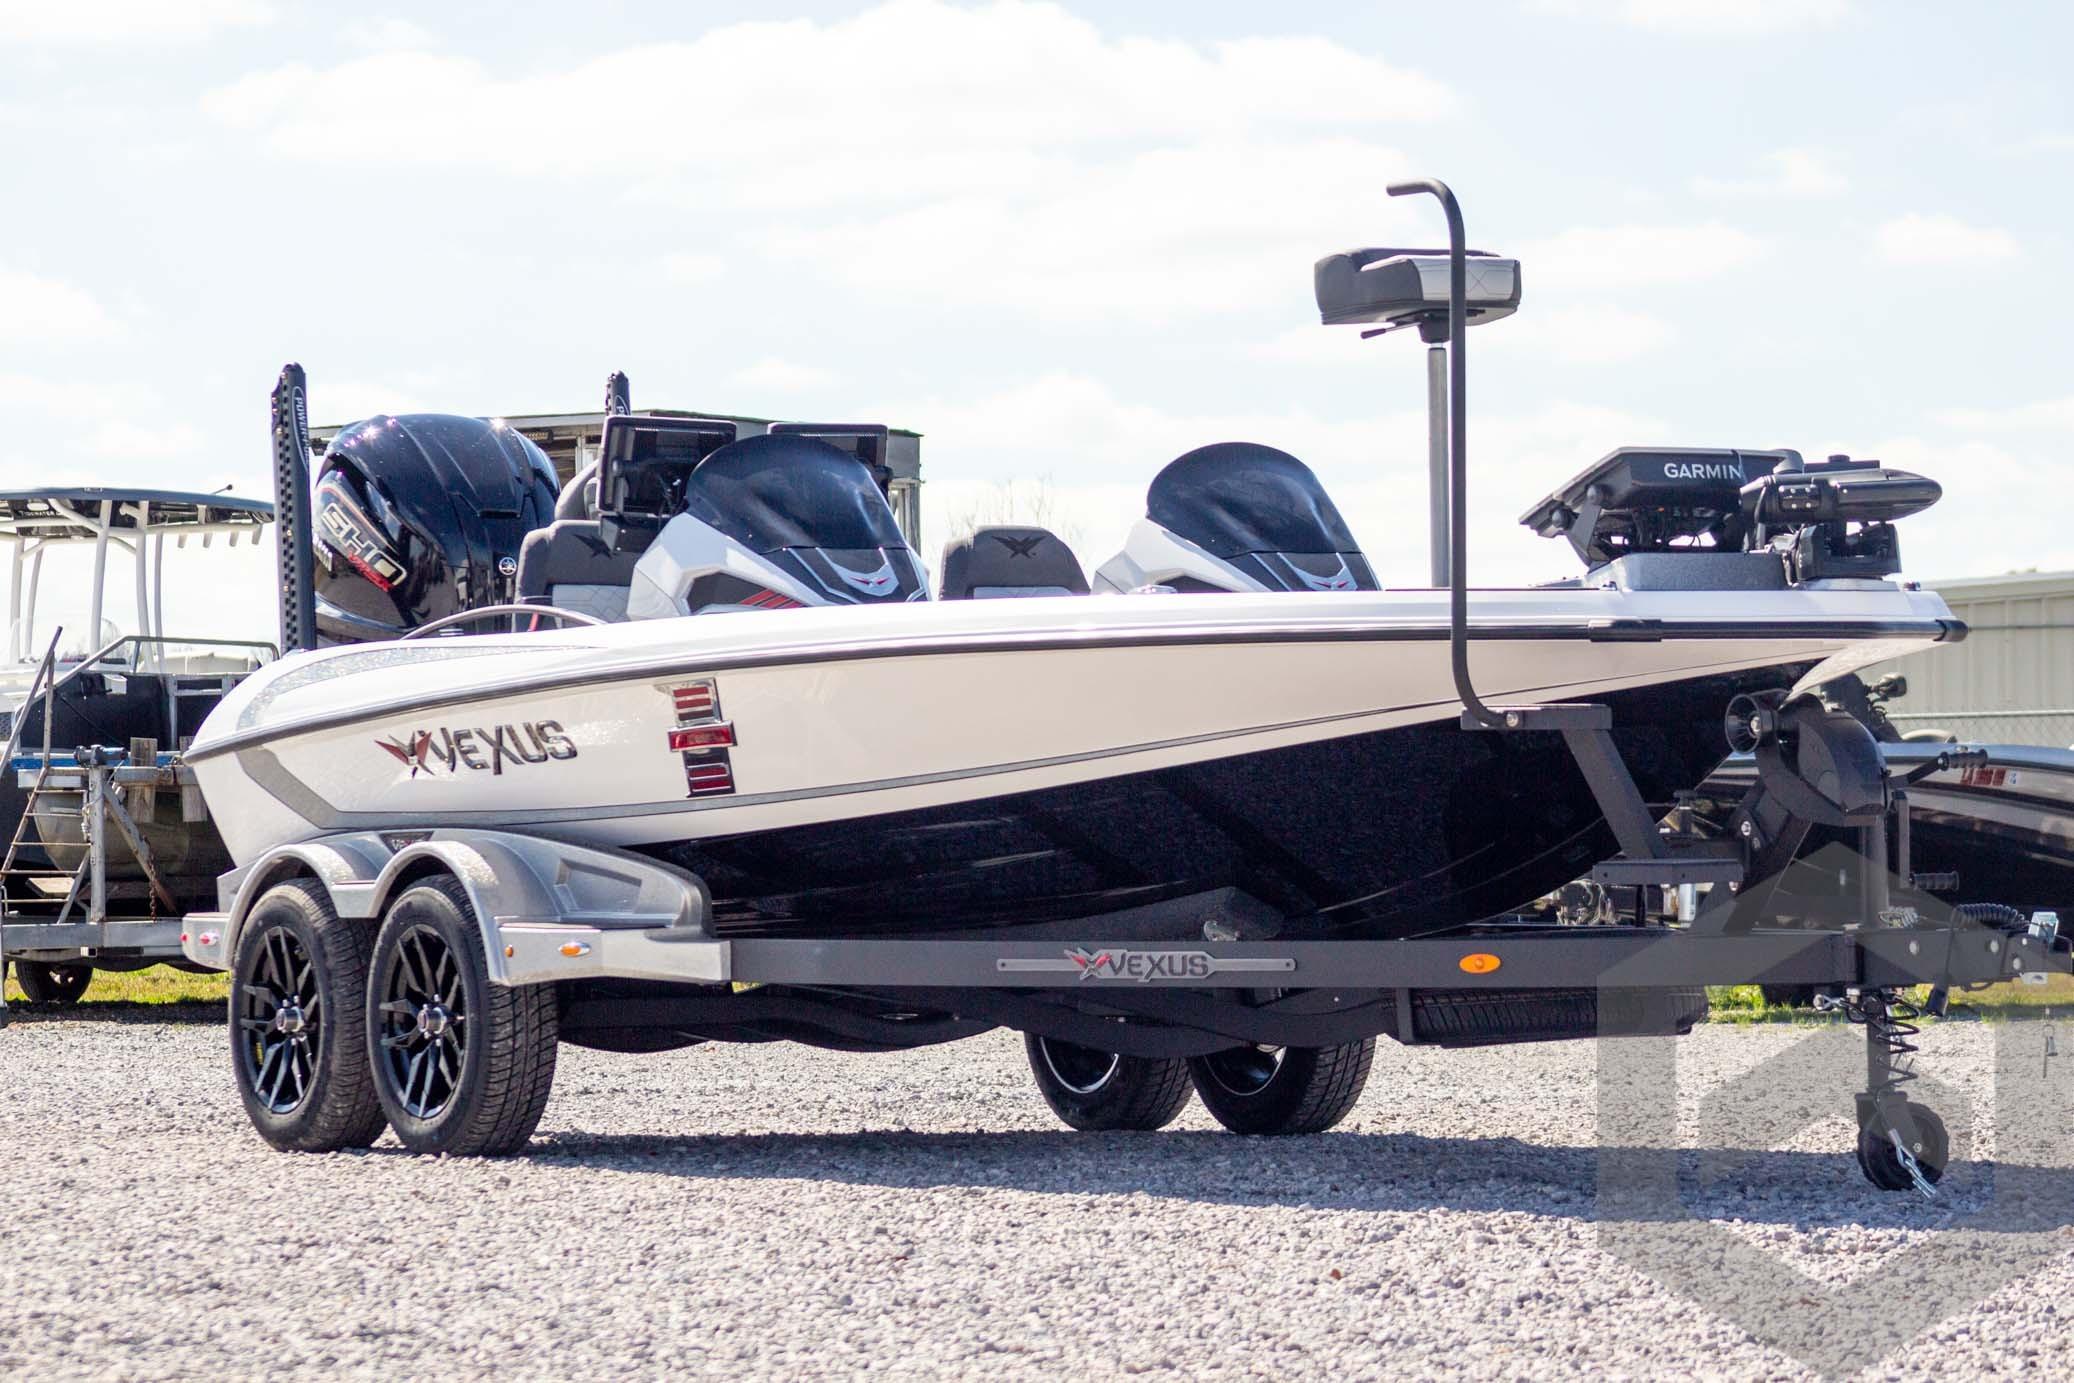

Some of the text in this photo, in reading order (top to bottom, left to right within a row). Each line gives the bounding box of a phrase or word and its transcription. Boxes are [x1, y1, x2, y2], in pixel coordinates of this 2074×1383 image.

[1663, 462, 1742, 479] GARMIN
[320, 503, 407, 586] SHO
[417, 719, 578, 776] VEXUS
[1107, 951, 1209, 980] VEXUS
